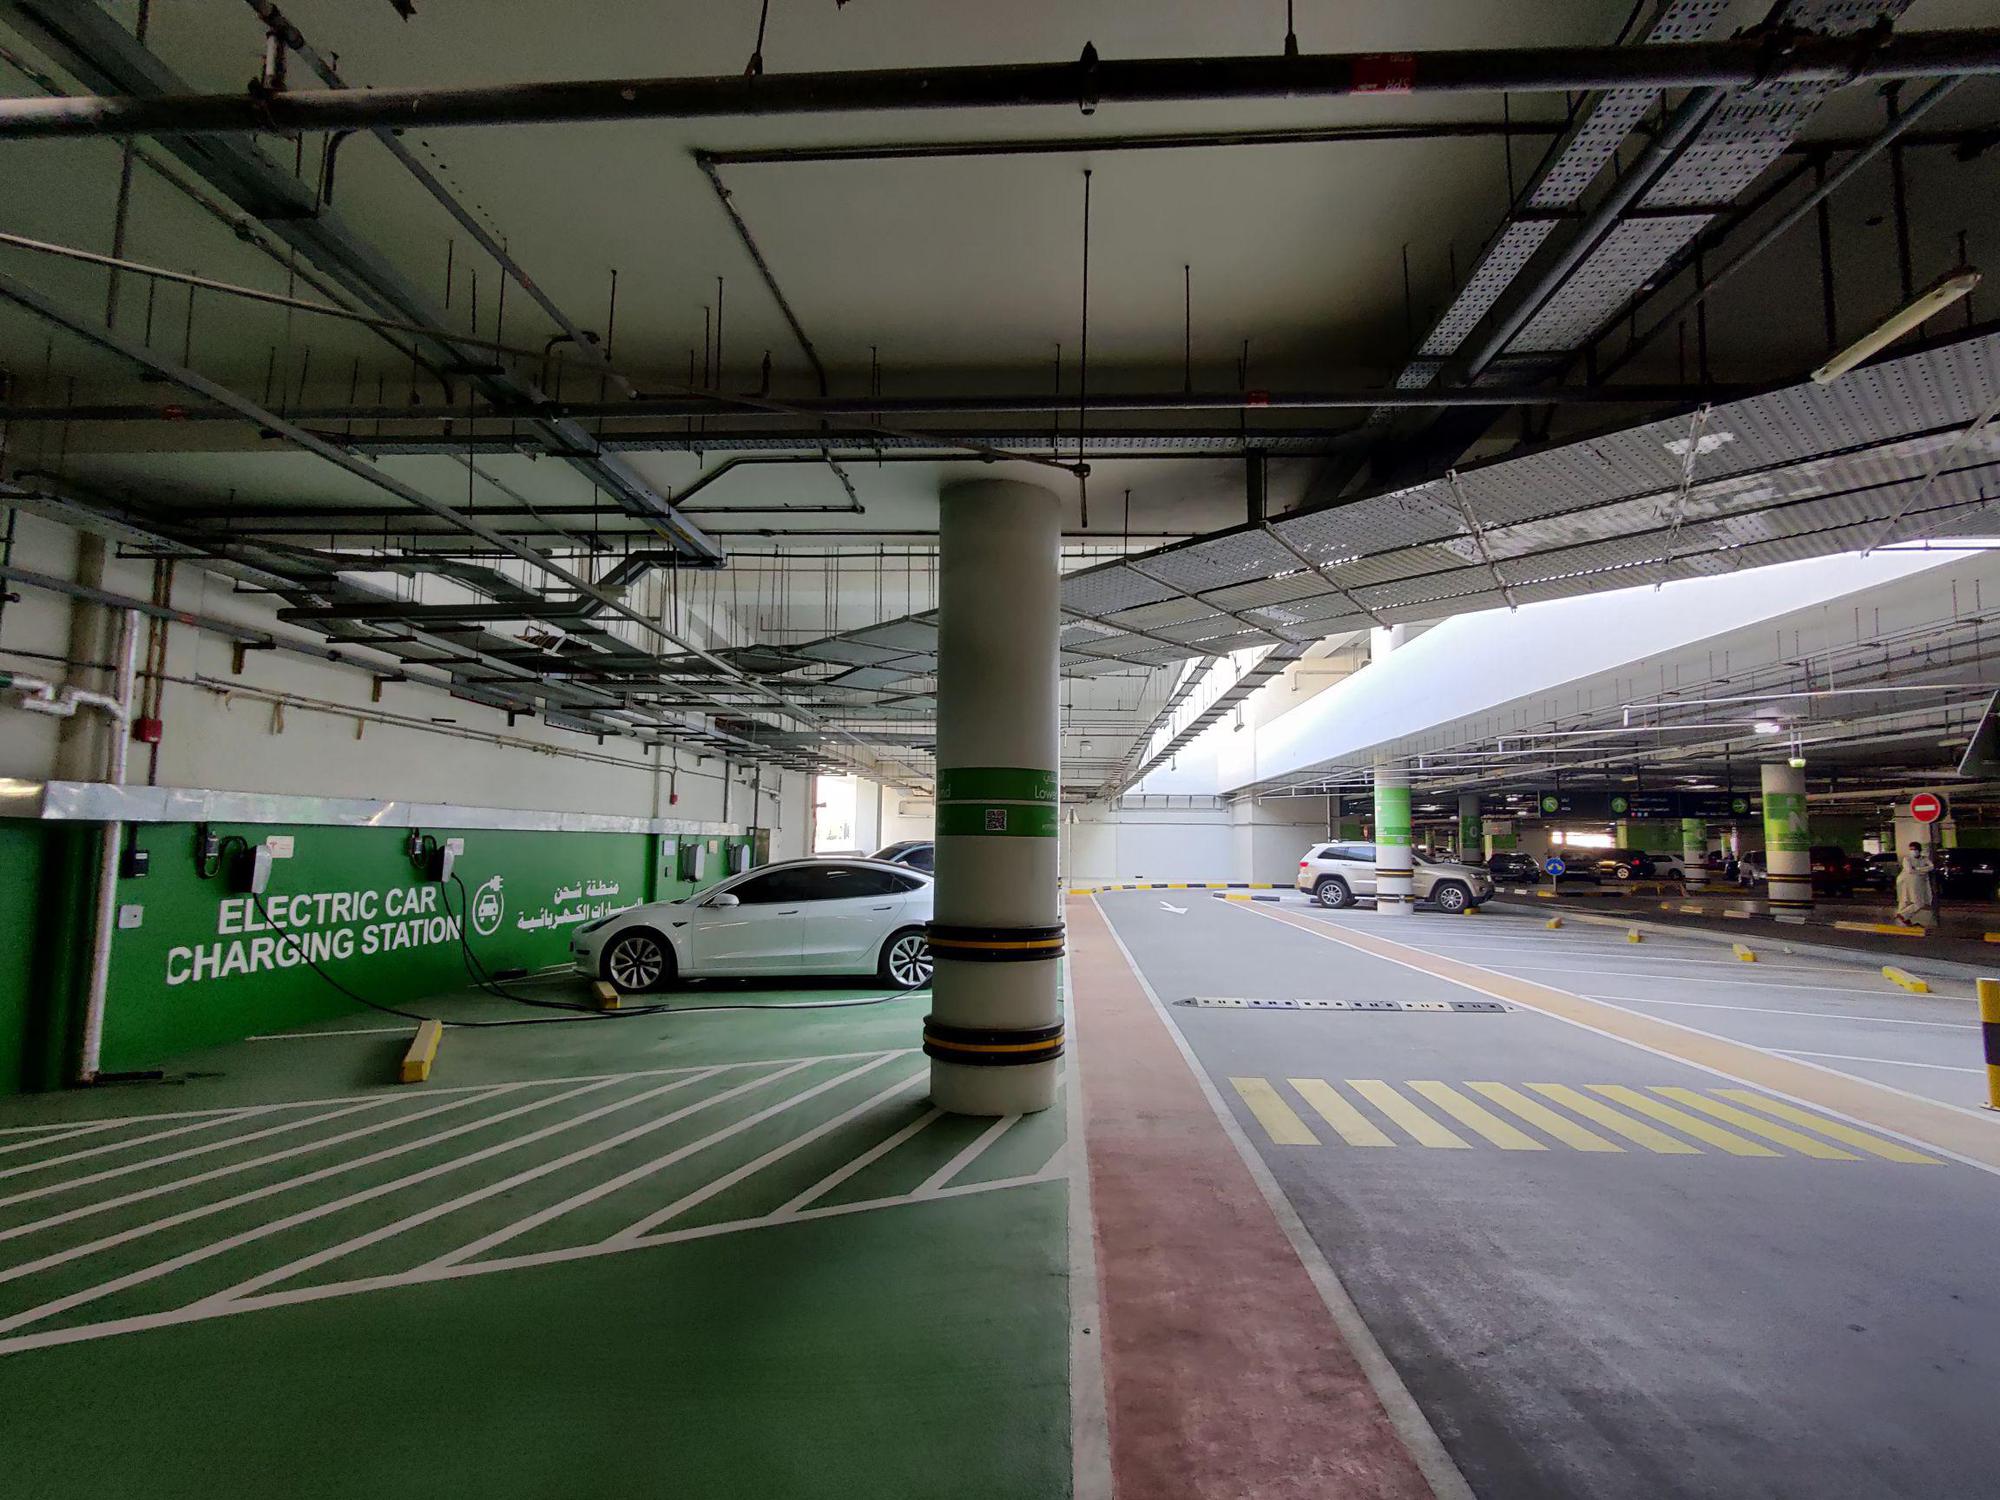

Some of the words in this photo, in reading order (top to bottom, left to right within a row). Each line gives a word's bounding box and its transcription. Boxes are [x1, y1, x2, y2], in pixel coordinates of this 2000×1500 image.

[554, 881, 582, 904] شحن
[586, 880, 619, 896] منطقة
[218, 892, 379, 934] ELECTRIC
[385, 886, 437, 917] CAR
[517, 903, 590, 933] الكهربائية
[166, 928, 354, 985] CHARGING
[361, 915, 461, 955] STATION
